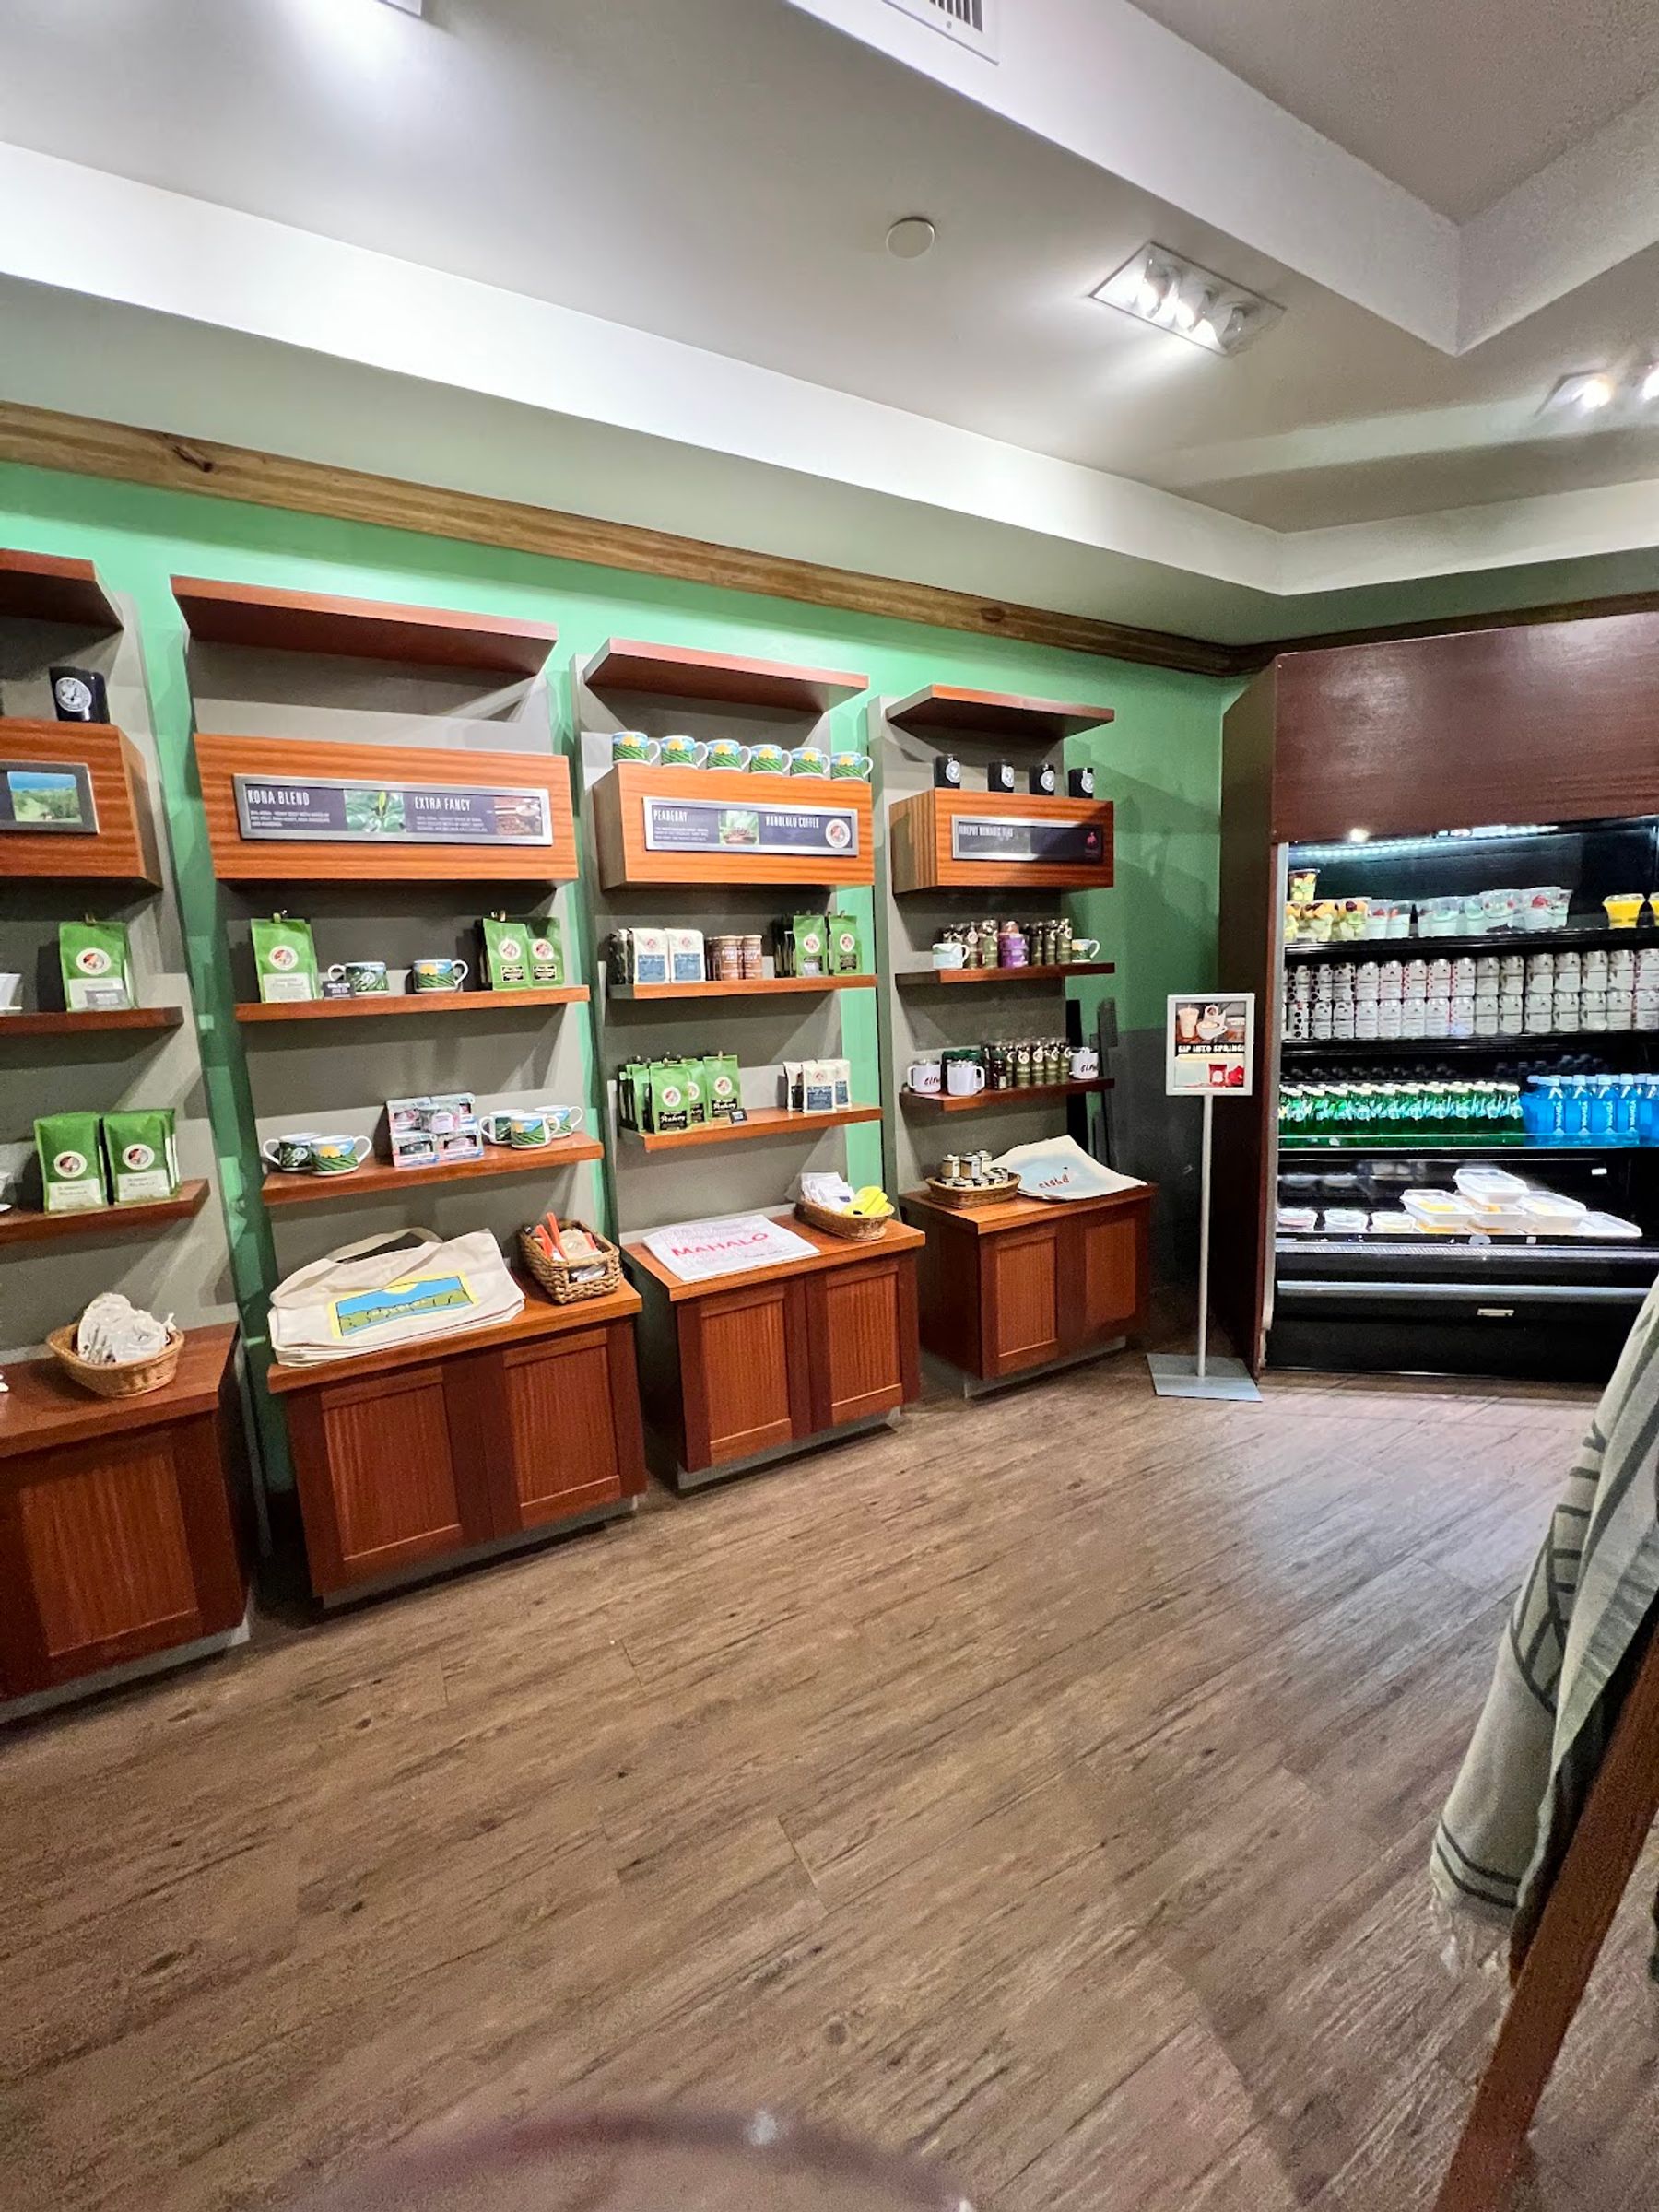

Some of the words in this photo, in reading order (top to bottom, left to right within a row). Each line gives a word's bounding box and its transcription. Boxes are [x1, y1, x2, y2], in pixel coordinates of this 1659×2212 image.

[247, 789, 275, 804] KONA
[278, 791, 310, 806] BLEND
[415, 796, 441, 810] EXTRA
[444, 798, 471, 811] FANCY
[653, 810, 688, 822] PEABERRY
[799, 817, 819, 829] COFFEE
[671, 1232, 769, 1257] MAHALO
